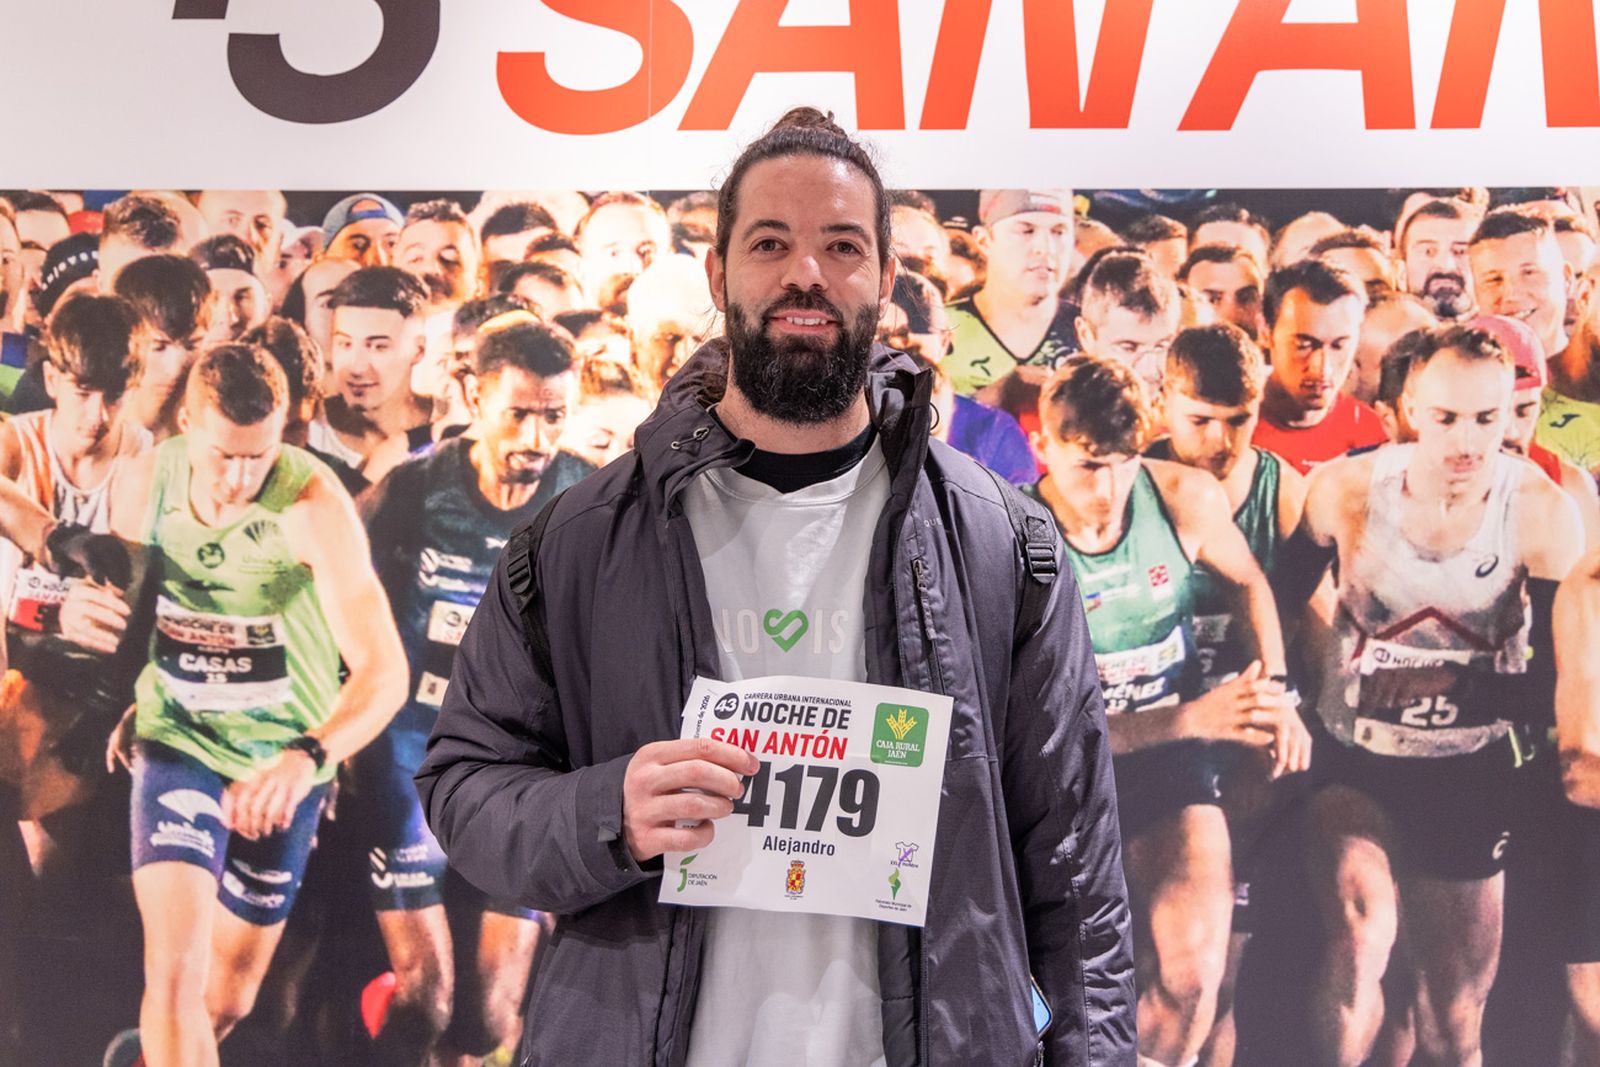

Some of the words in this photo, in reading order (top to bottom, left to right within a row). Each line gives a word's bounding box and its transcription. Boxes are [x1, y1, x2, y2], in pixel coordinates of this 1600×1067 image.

[813, 608, 849, 655] IS
[178, 652, 253, 674] CASAS
[714, 697, 738, 713] 43
[744, 693, 773, 701] CARRERA
[773, 694, 801, 702] URBANA
[801, 696, 852, 707] INTERNACIONAL
[1401, 695, 1459, 727] 25
[740, 701, 817, 728] NOCHE
[821, 707, 852, 730] DE
[710, 727, 760, 752] SAN
[762, 729, 848, 761] ANTÓN
[875, 739, 895, 750] CAJA
[895, 741, 921, 753] RURAL
[731, 760, 880, 837] 4179
[762, 835, 836, 856] Alejandro
